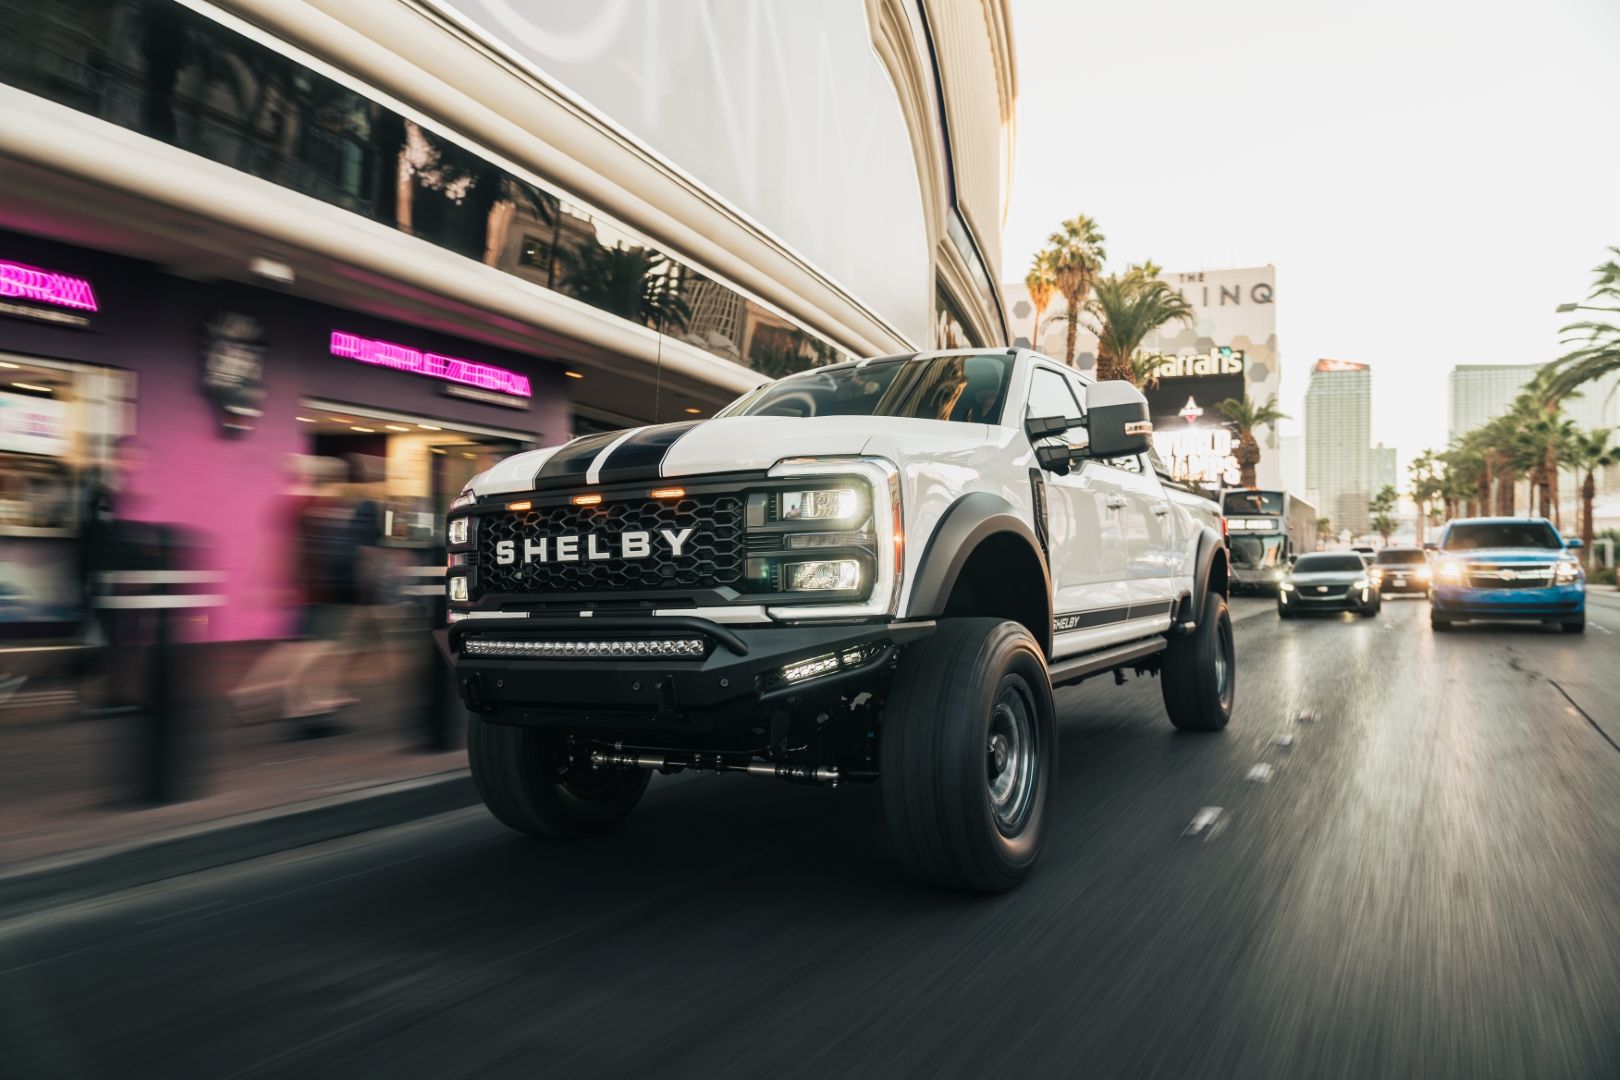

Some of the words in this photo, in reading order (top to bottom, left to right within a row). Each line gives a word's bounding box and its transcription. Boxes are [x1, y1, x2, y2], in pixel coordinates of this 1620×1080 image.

[1179, 272, 1205, 283] THE
[496, 528, 694, 565] SHELBY
[1053, 615, 1080, 630] SHELBY
